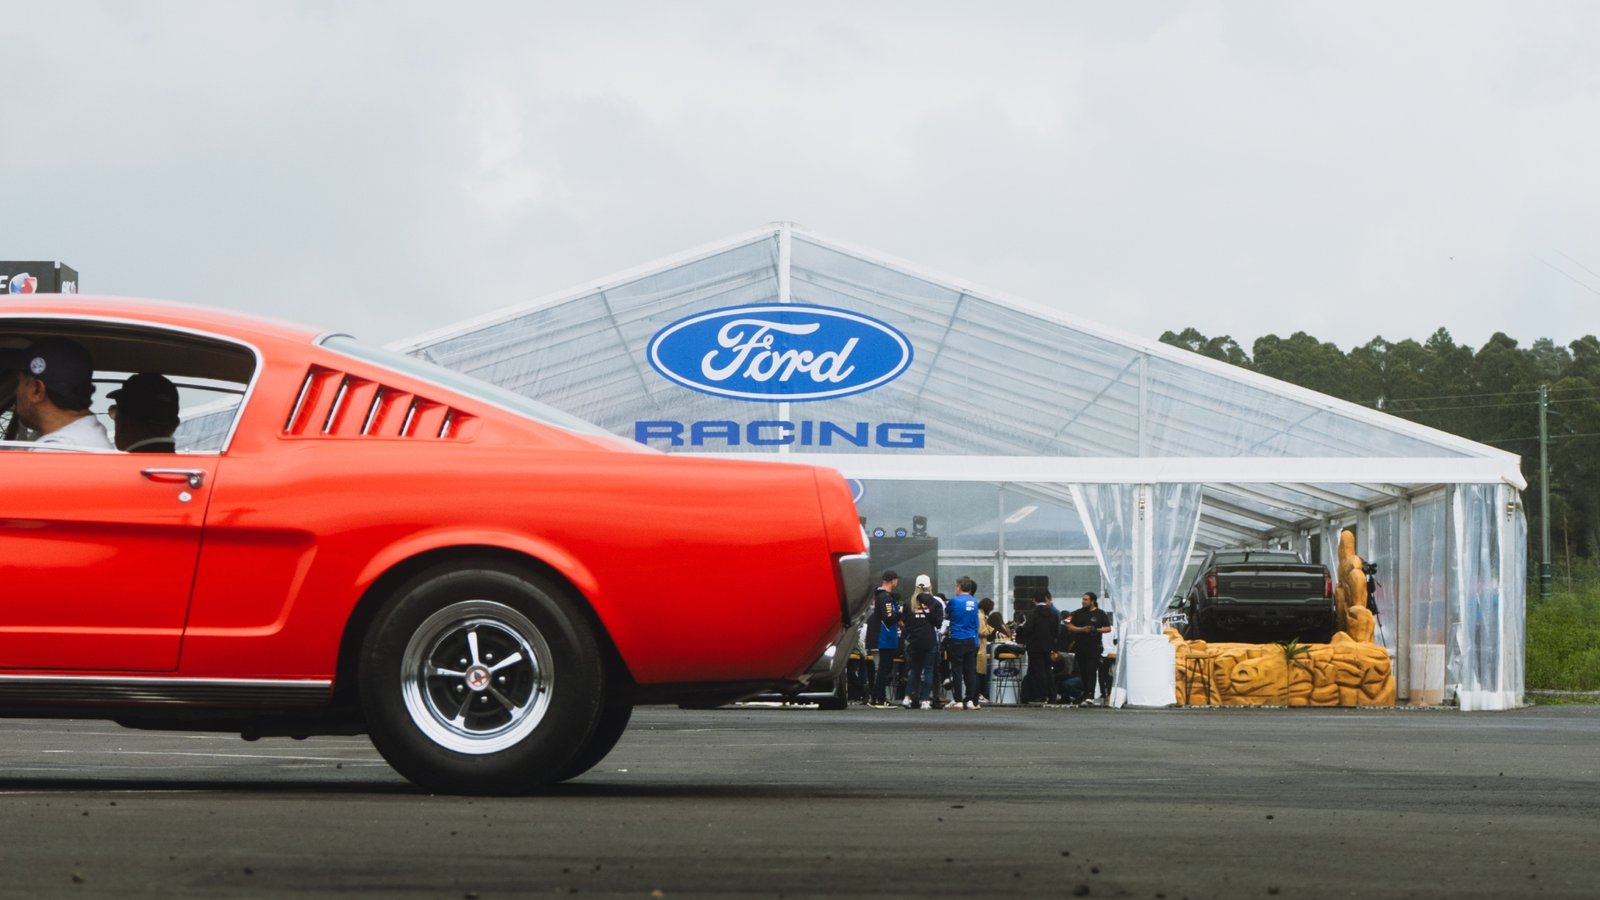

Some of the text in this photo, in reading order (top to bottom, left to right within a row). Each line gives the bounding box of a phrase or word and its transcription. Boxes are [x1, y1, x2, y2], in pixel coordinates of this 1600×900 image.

[701, 319, 860, 383] Ford
[635, 420, 925, 448] RACING
[1230, 581, 1312, 589] FORD
